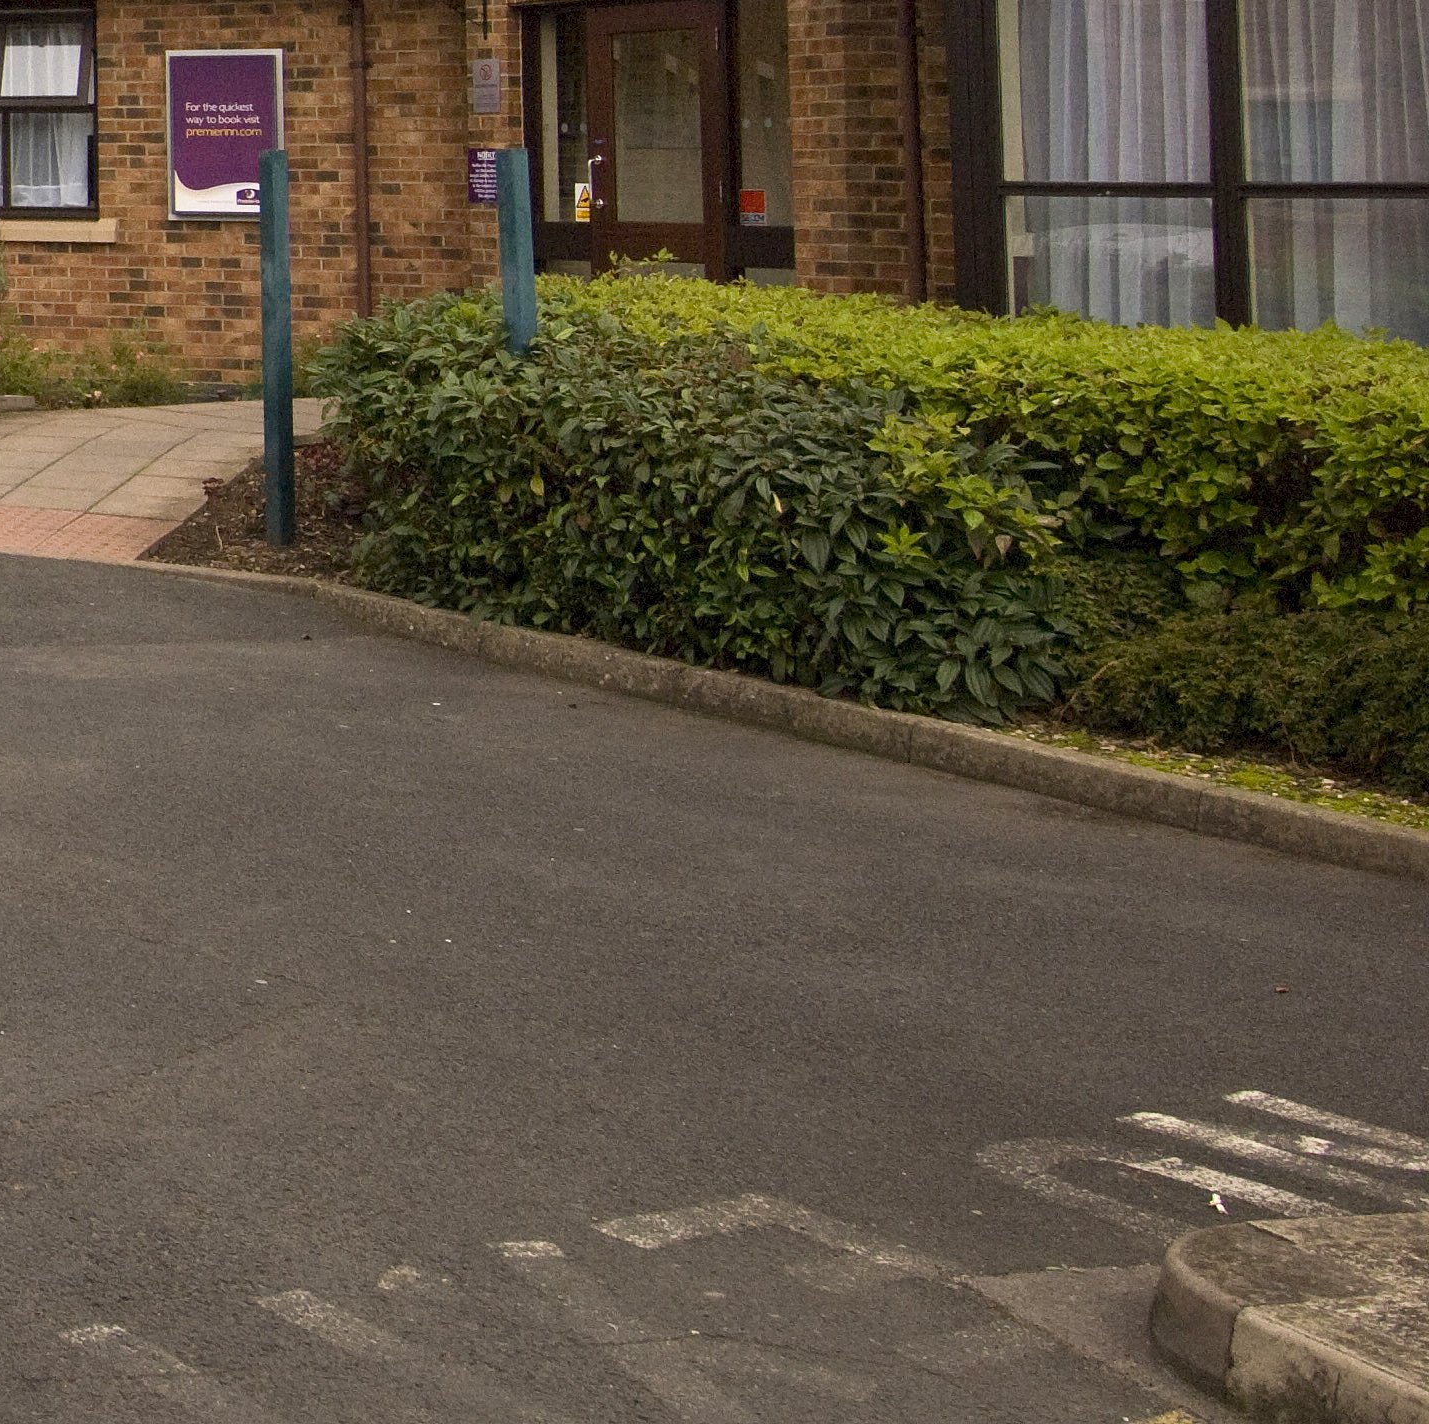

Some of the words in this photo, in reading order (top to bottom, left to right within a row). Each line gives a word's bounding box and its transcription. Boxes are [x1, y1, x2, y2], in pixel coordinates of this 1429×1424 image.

[185, 102, 201, 112] For
[202, 102, 218, 112] the
[219, 102, 254, 113] quickest
[185, 116, 204, 126] way
[206, 116, 217, 124] to
[218, 115, 242, 124] book
[243, 115, 260, 124] visit
[186, 127, 263, 138] premierinn.com
